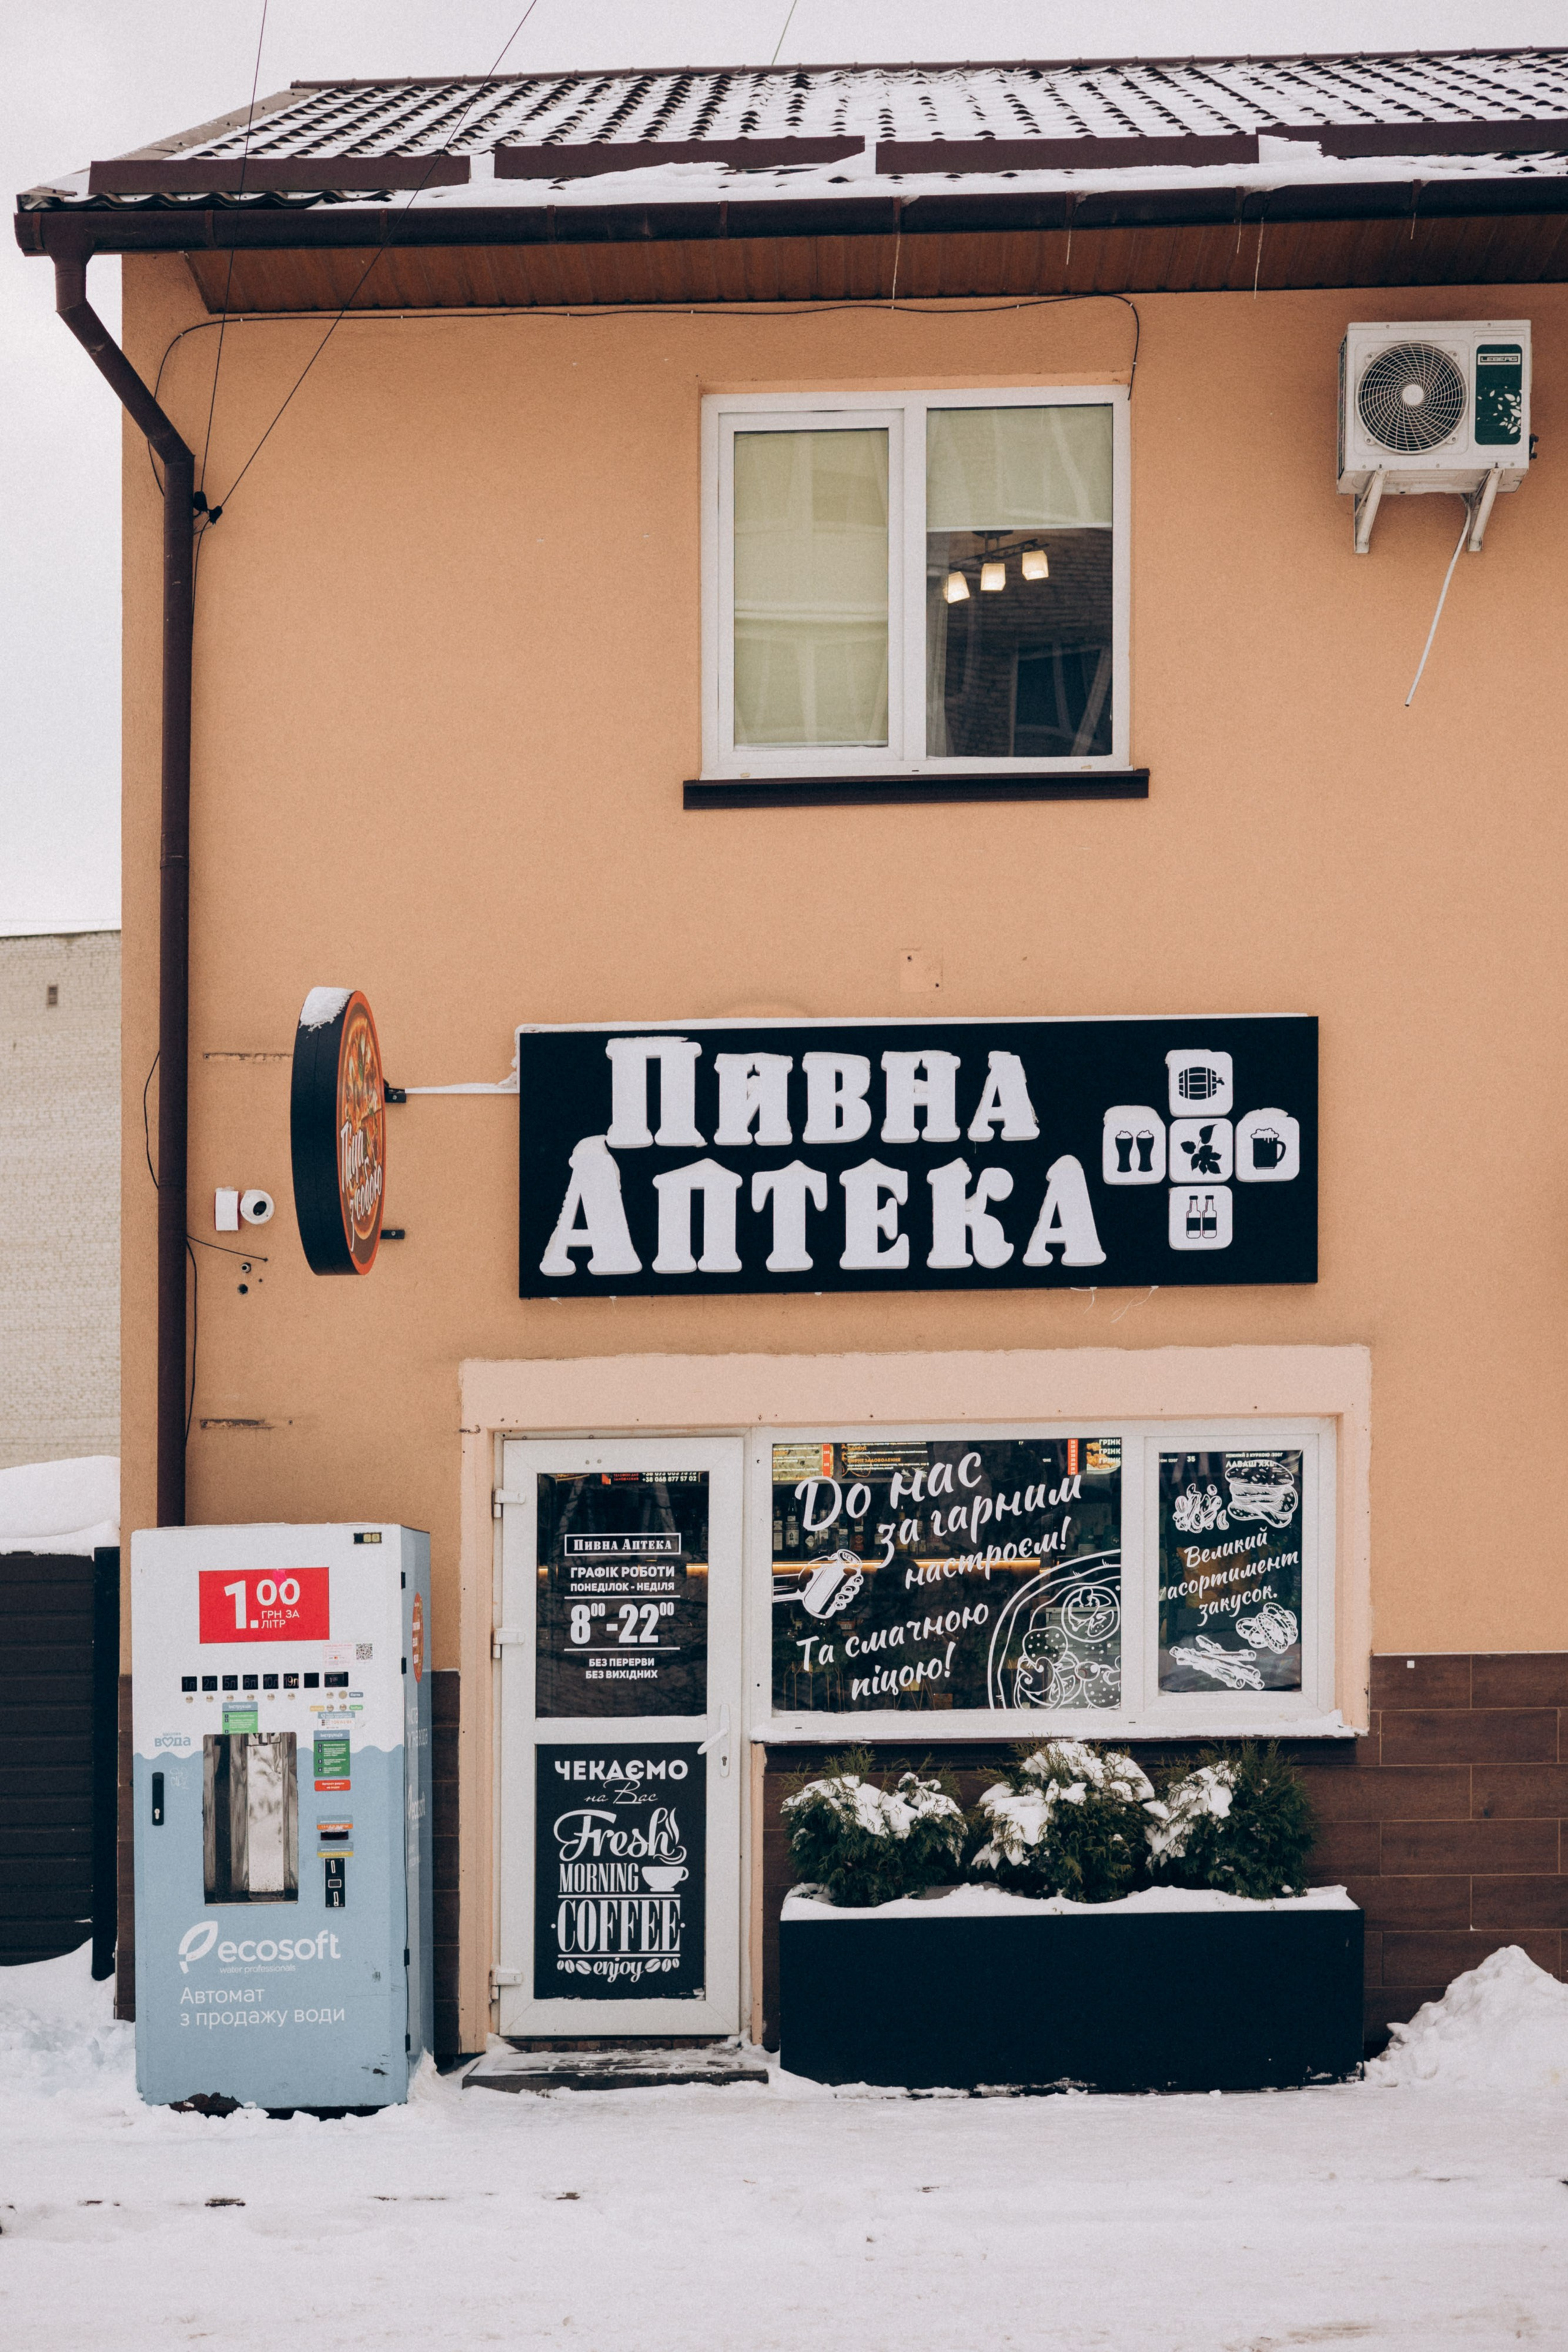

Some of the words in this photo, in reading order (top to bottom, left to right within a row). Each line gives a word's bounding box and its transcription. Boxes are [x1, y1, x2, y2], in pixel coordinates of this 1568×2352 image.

[606, 1037, 1040, 1148] ПИВНА
[341, 1120, 364, 1193] Піца
[356, 1156, 382, 1221] собою
[539, 1136, 1106, 1275] АПТЕКА
[794, 1476, 872, 1531] До
[889, 1452, 982, 1509] нас
[874, 1523, 919, 1569] за
[931, 1475, 1082, 1543] гарним
[573, 1539, 619, 1551] ПИВНА
[622, 1538, 672, 1551] АПТЕКА
[905, 1517, 1072, 1589] настроєм!
[1183, 1526, 1268, 1568] Великий
[570, 1566, 619, 1578] ГРАФІК
[621, 1566, 675, 1578] РОБОТИ
[570, 1582, 630, 1593] ПОНЕДІЛОК
[636, 1581, 675, 1592] НЕДІЛЯ
[1167, 1550, 1299, 1600] асортимент
[261, 1610, 282, 1619] ГРН
[285, 1610, 300, 1618] ЗА
[1197, 1585, 1278, 1627] закусок.
[261, 1619, 286, 1629] ЛІТР
[796, 1635, 834, 1671] Та
[845, 1603, 989, 1657] смачною
[586, 1670, 605, 1679] БЕЗ
[607, 1670, 658, 1680] ВИХІДНИХ
[589, 1658, 608, 1667] БЕЗ
[609, 1657, 655, 1667] ПЕРЕРВИ
[851, 1642, 956, 1700] піцою!
[554, 1760, 688, 1780] ЧЕКАЄМО
[584, 1793, 609, 1803] на
[603, 1777, 658, 1804] Вас
[554, 1807, 676, 1861] Fresh
[559, 1863, 639, 1893] MORNING
[557, 1899, 681, 1952] COFFEE
[217, 1929, 341, 1962] ecosoft
[244, 1964, 296, 1975] professionals
[593, 1957, 644, 1983] enjoy
[180, 1987, 265, 2004] Автомат
[180, 2012, 189, 2026] з
[197, 2009, 288, 2029] продажу
[295, 2007, 345, 2024] води
